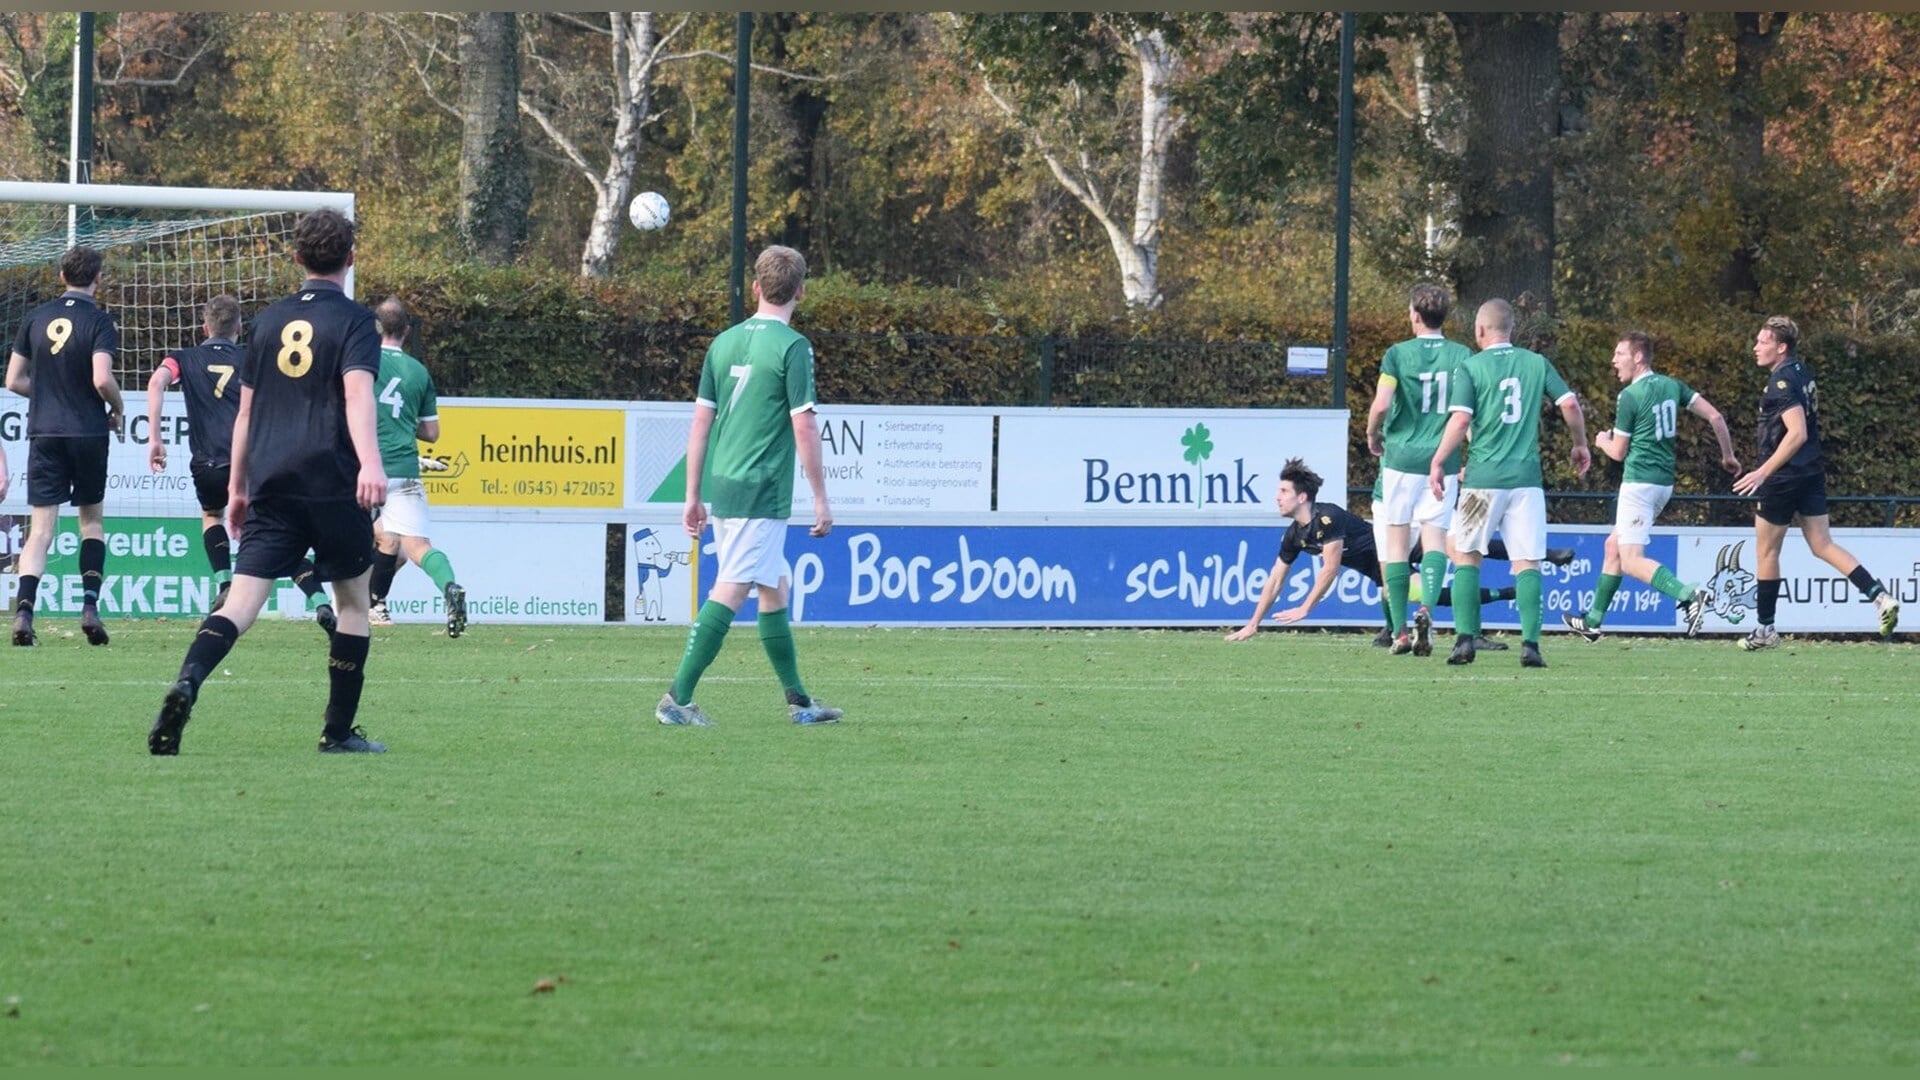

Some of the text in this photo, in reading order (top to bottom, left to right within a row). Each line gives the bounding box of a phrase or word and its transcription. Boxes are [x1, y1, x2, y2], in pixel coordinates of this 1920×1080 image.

[46, 317, 73, 355] 9
[276, 319, 314, 378] 8
[207, 364, 234, 399] 7
[379, 376, 403, 419] 4
[729, 364, 753, 414] 7
[1418, 371, 1448, 415] 11
[1499, 377, 1523, 425] 3
[820, 419, 864, 456] AN
[884, 420, 945, 434] Sierbestrating
[1652, 399, 1678, 441] 10
[480, 434, 617, 465] heinhuis.nl
[884, 439, 943, 453] Erfverharding
[107, 473, 189, 491] ONVEYING
[480, 479, 615, 497] Tel.: (0545) 472052
[848, 532, 1077, 606] Borsboom
[0, 574, 211, 614] PREKKEN
[433, 595, 520, 615] Finciële
[524, 596, 599, 616] diensten
[1547, 589, 1572, 612] 06
[1606, 590, 1631, 612] 99
[1634, 590, 1662, 613] 184
[1777, 577, 1919, 604] AUTO NIJ
